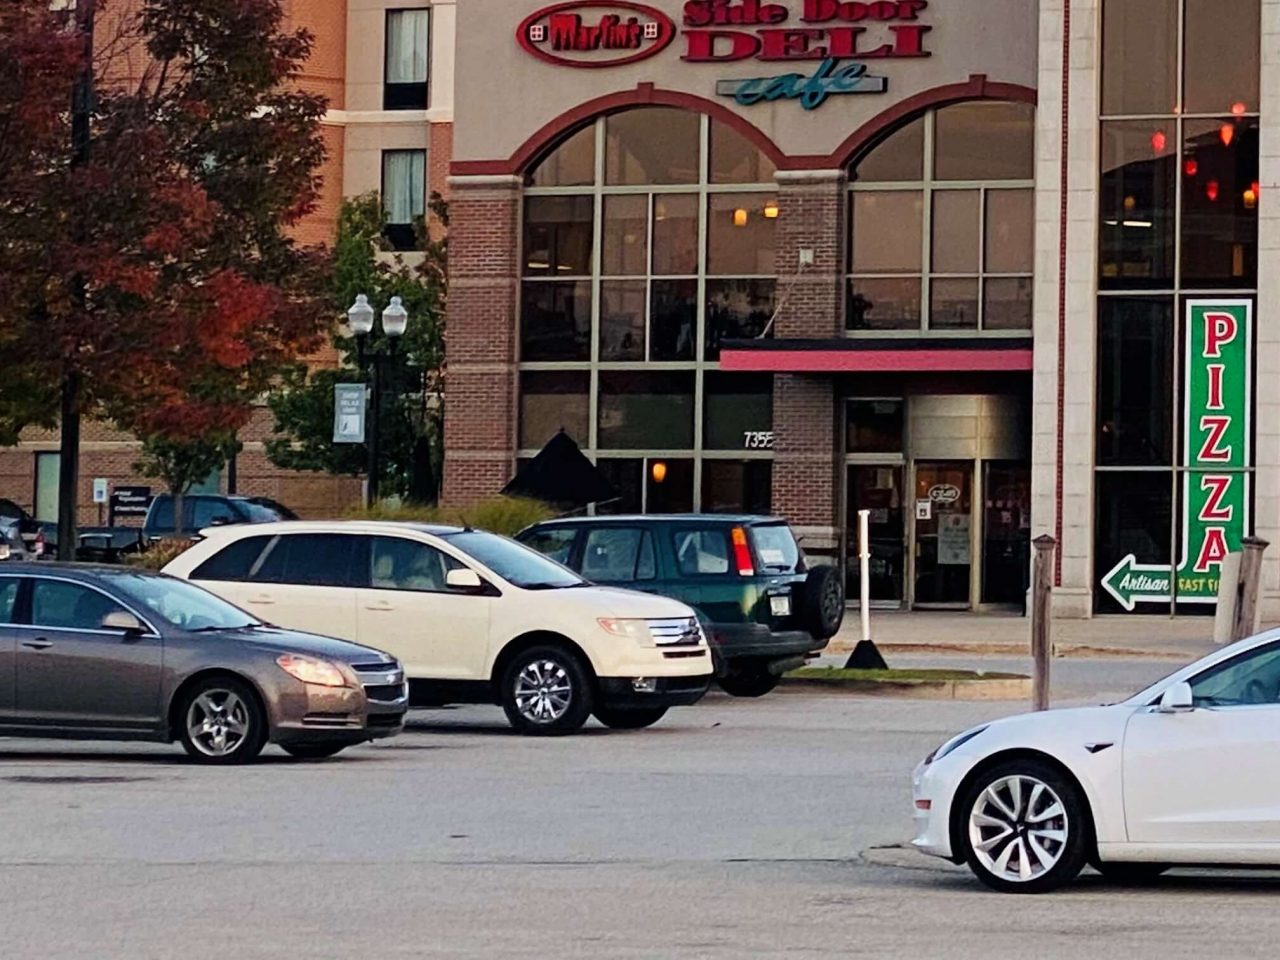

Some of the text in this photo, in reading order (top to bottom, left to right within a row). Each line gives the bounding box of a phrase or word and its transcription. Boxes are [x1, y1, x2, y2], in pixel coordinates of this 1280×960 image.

[549, 13, 642, 51] Martin's
[680, 25, 933, 62] DELI
[744, 431, 774, 448] 7355
[1194, 311, 1238, 573] PIZZA
[1119, 573, 1170, 591] Artisan
[1178, 578, 1206, 592] FAST
